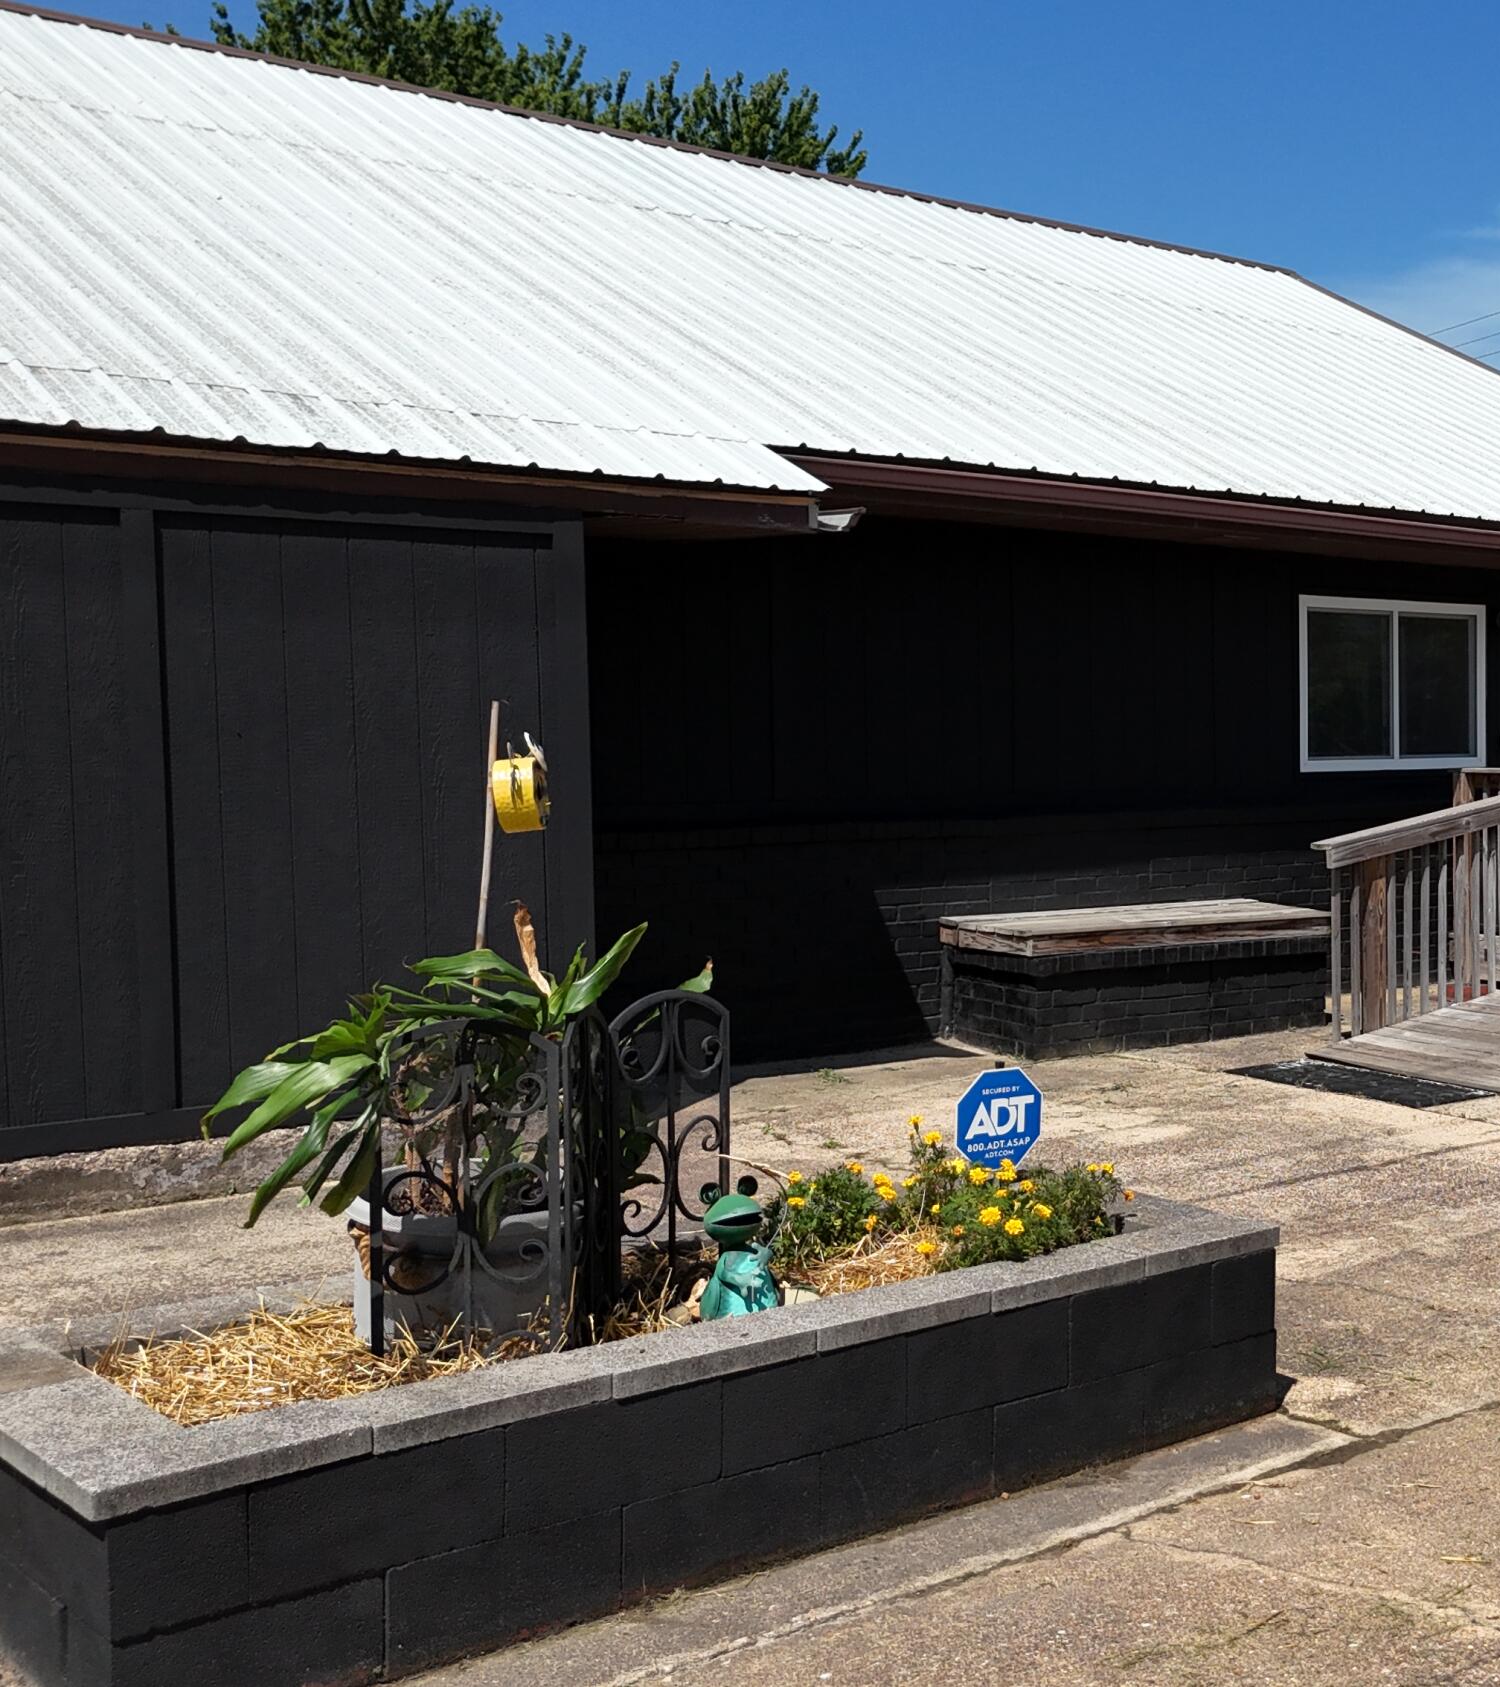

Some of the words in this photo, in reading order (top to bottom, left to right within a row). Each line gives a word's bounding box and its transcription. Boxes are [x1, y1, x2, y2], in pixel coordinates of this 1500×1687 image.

[981, 1086, 1011, 1095] SECURED
[964, 1094, 1035, 1140] ADT
[967, 1136, 1031, 1153] 800.ADT.ASAP
[984, 1149, 1015, 1159] ADT.COM
